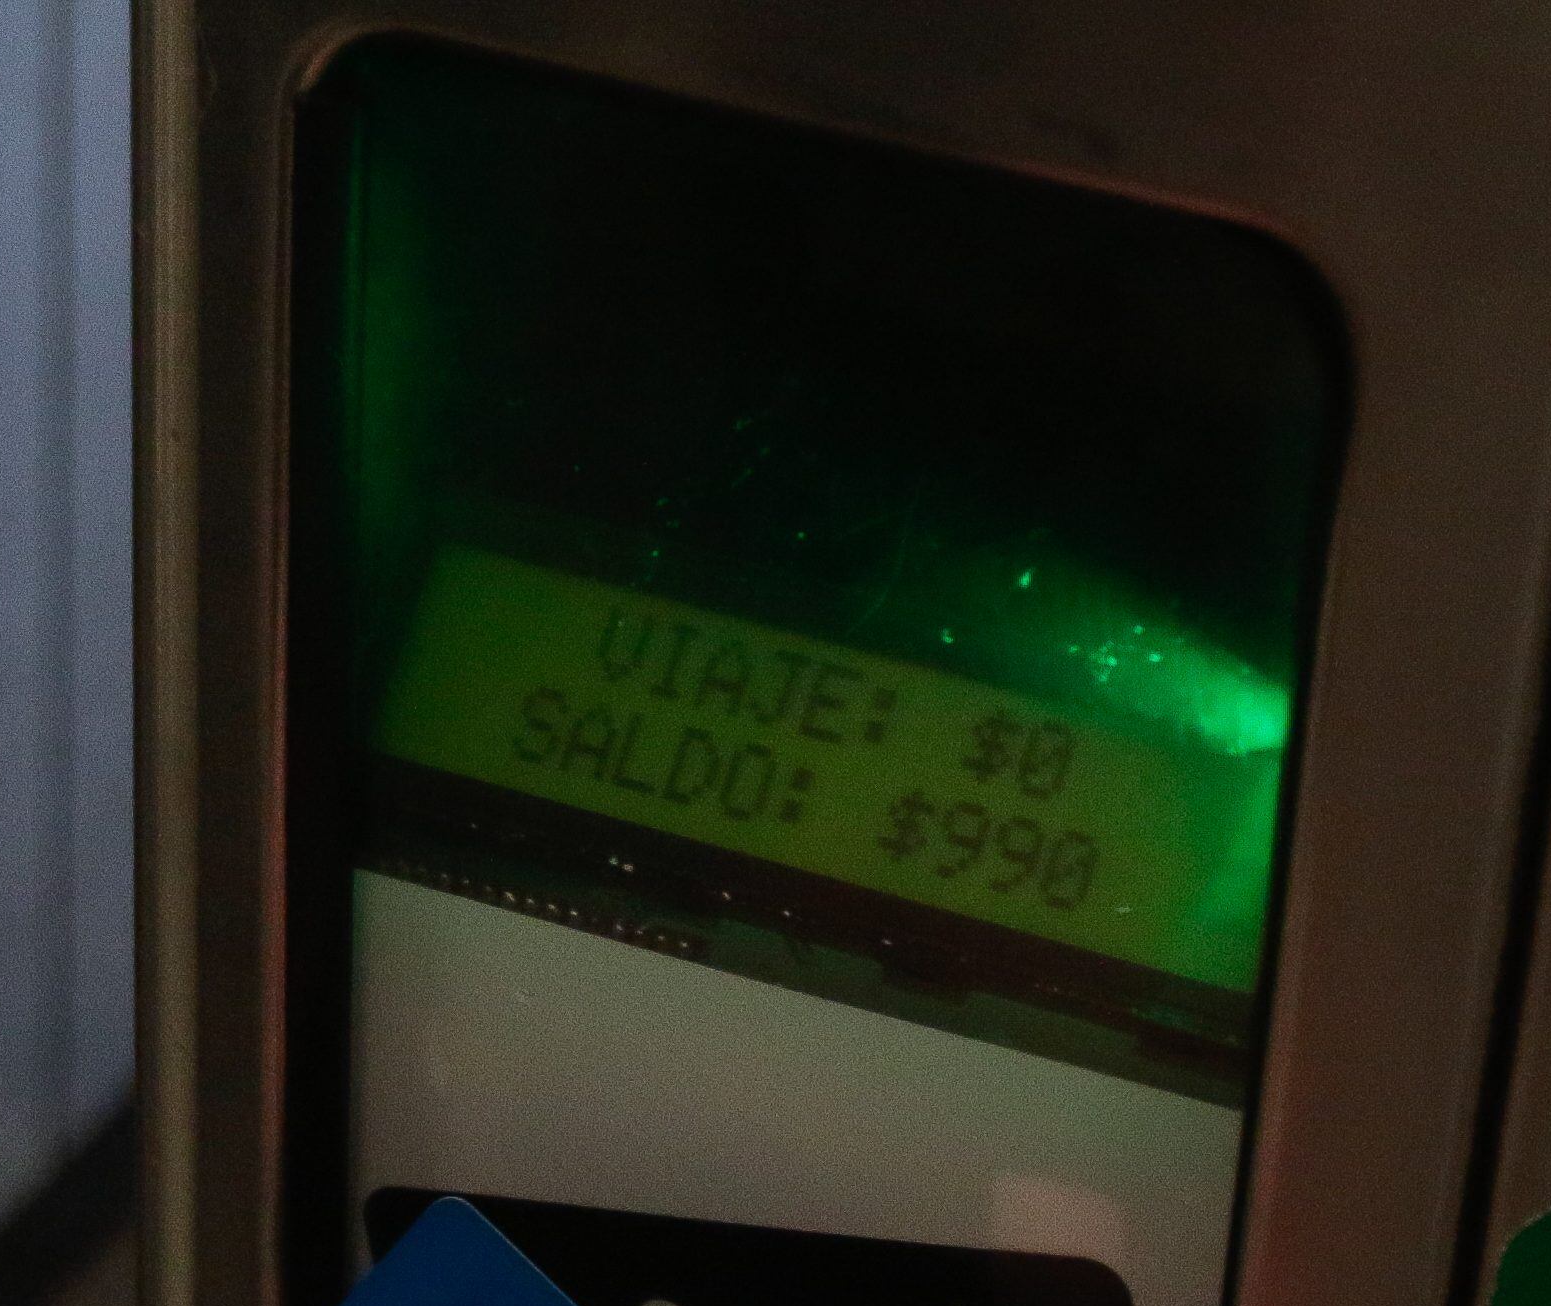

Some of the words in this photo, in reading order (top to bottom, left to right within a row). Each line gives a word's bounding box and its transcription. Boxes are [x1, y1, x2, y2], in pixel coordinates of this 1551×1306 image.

[512, 686, 816, 826] SALDO:
[875, 790, 1102, 912] $990
[594, 603, 898, 744] VIAJE:
[962, 705, 1080, 800] $0
